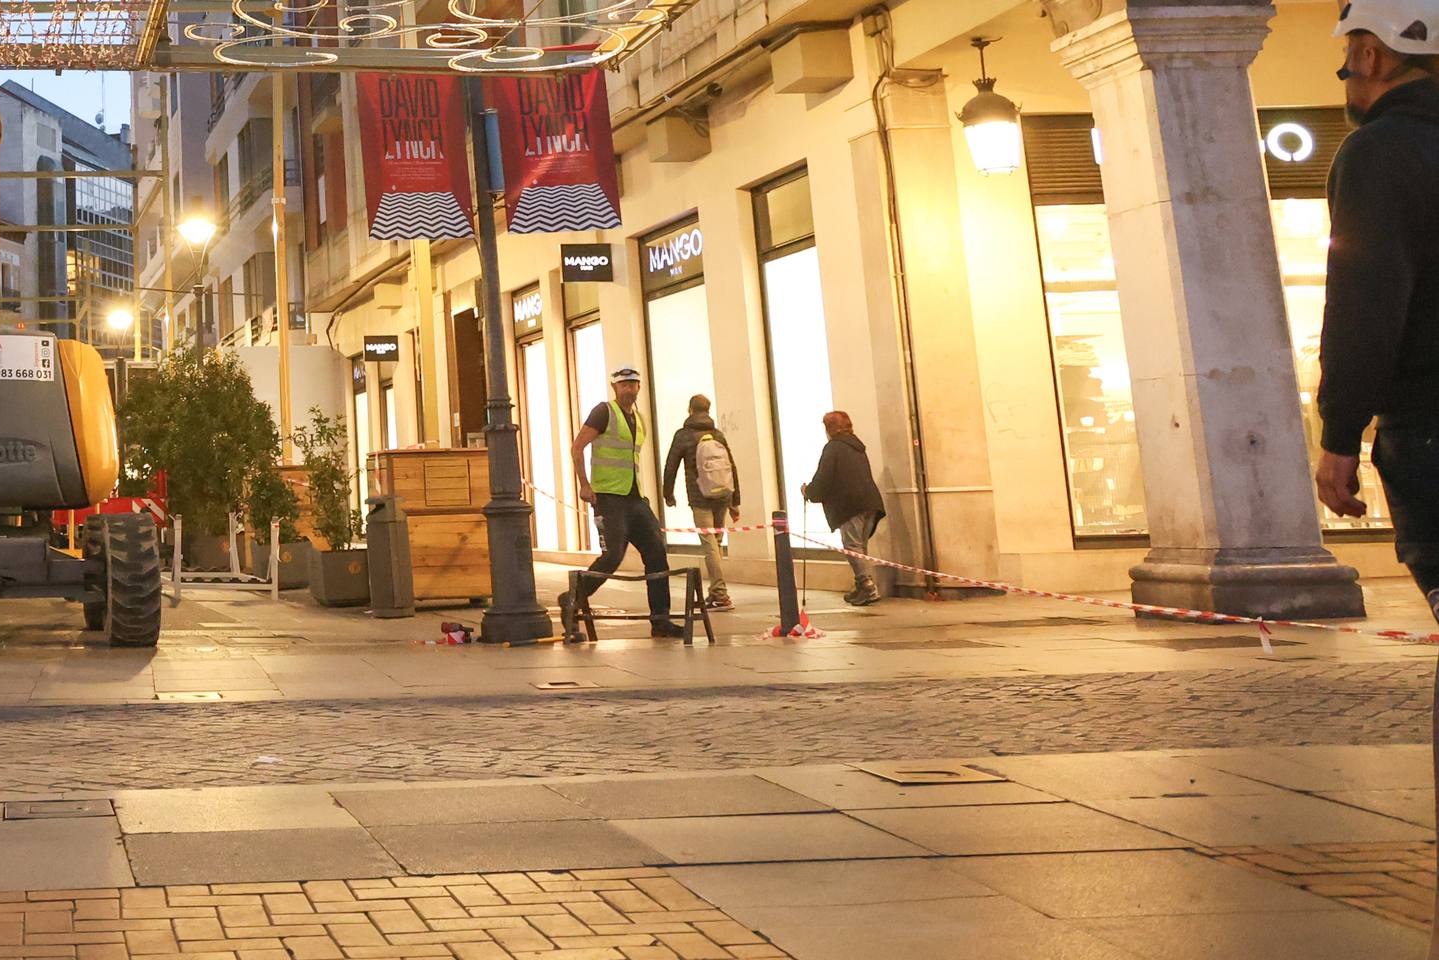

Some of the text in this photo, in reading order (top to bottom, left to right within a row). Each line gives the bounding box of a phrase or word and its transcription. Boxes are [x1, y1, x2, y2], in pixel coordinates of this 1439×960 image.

[378, 78, 440, 119] DAVID
[516, 74, 585, 115] DAVID
[382, 117, 445, 160] LYNCH
[520, 110, 590, 157] LYNCH
[564, 255, 609, 266] MANGO
[649, 228, 703, 273] MANGO
[514, 292, 543, 323] MANG
[365, 343, 397, 351] MANGO
[15, 370, 34, 379] 668
[36, 370, 52, 379] 031
